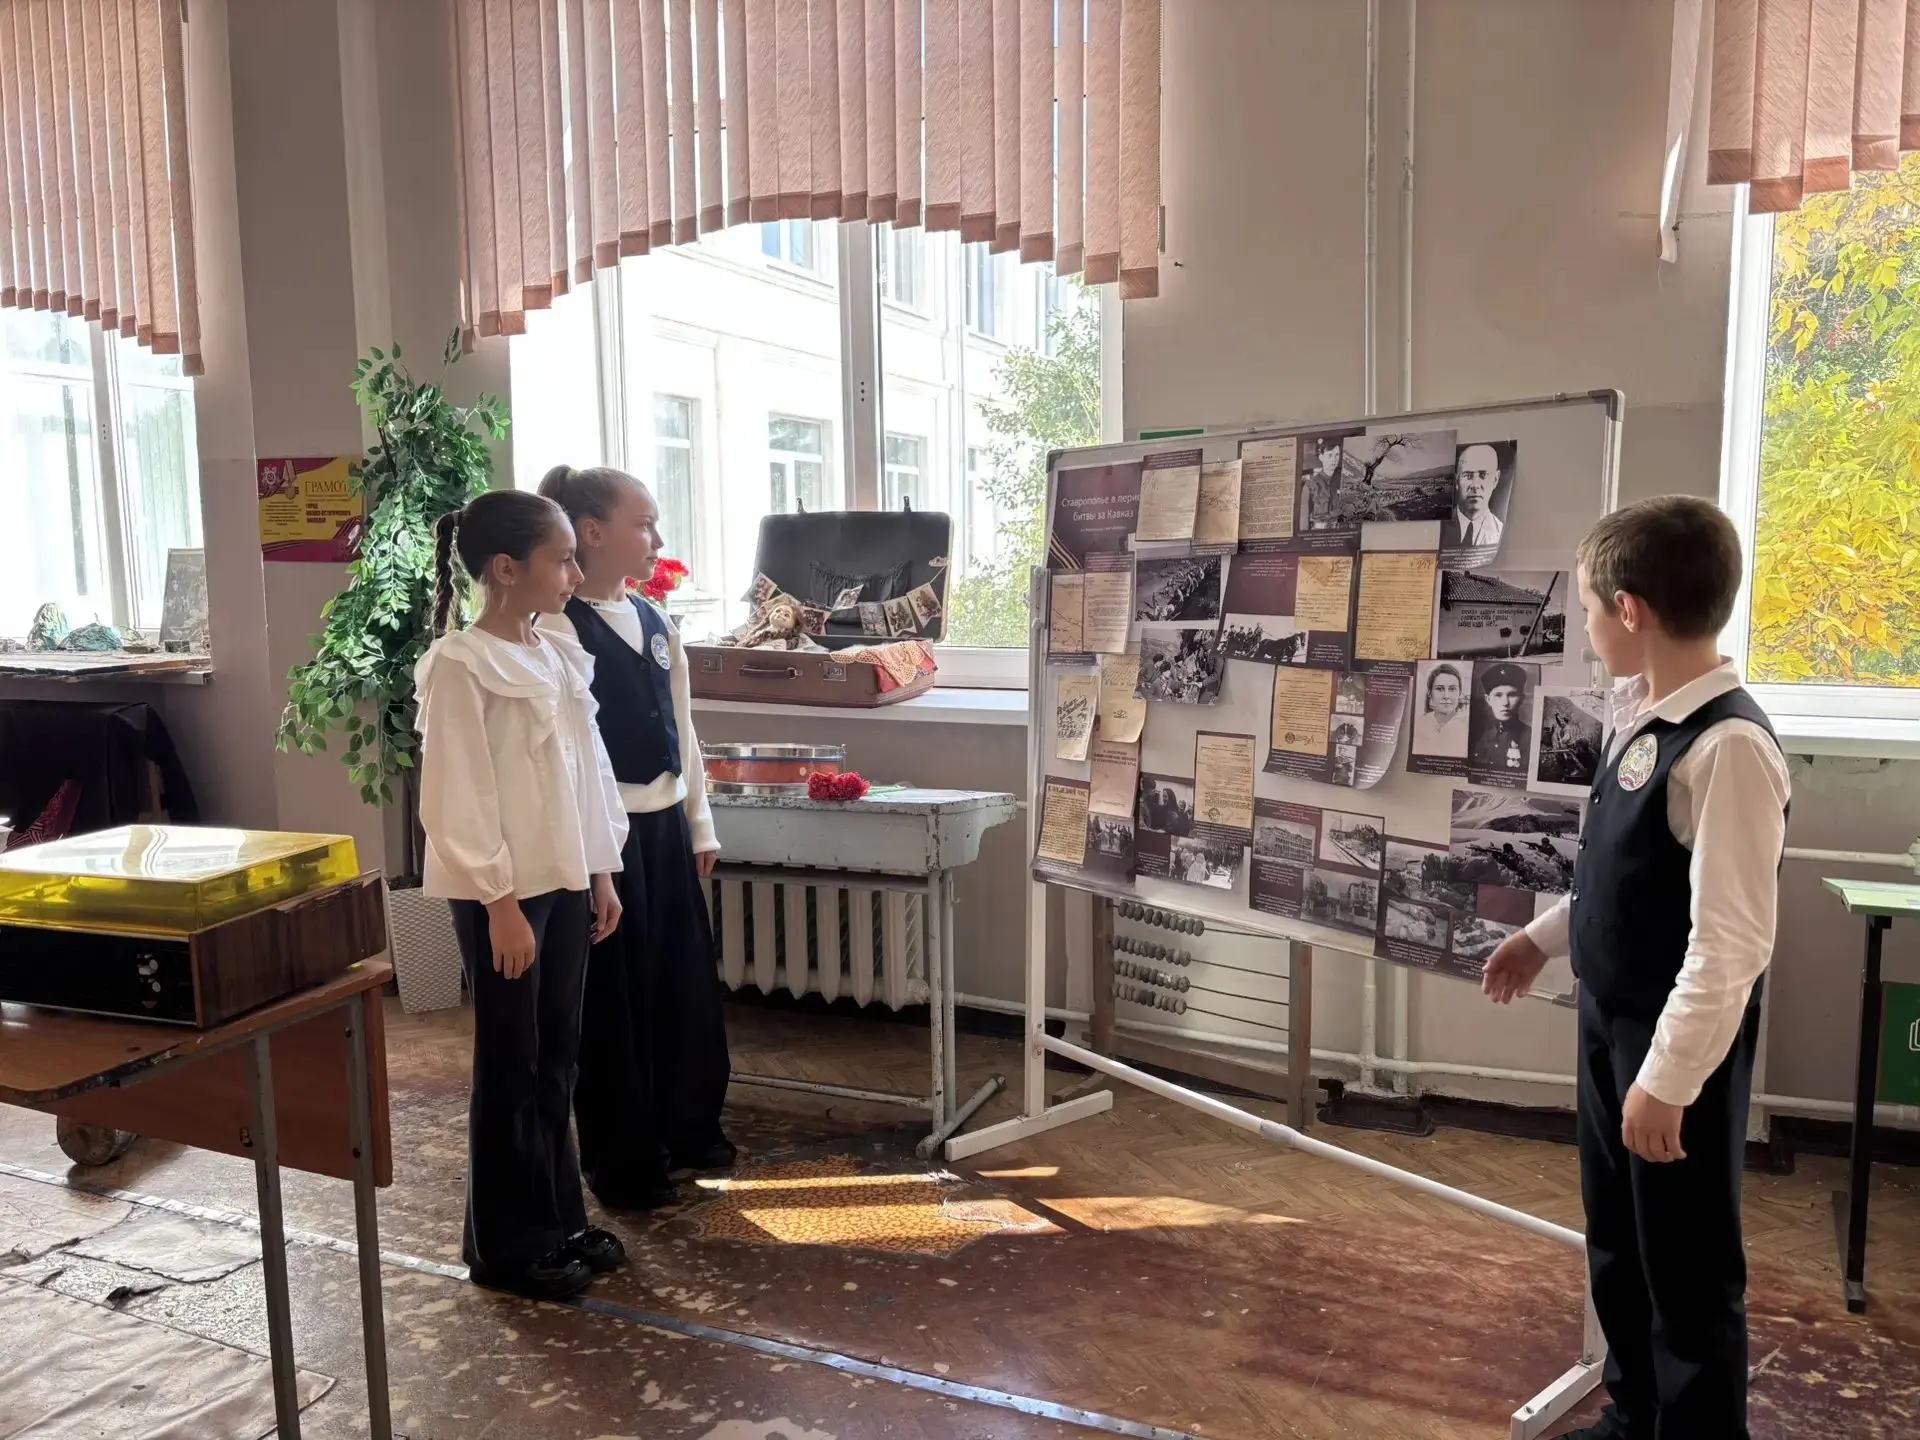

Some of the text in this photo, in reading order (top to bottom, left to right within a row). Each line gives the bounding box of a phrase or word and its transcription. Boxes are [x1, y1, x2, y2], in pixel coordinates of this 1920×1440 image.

[305, 480, 350, 493] ГРАМОТ
[1061, 496, 1109, 508] Ставрополье
[1073, 509, 1134, 521] битвы за Кавказ
